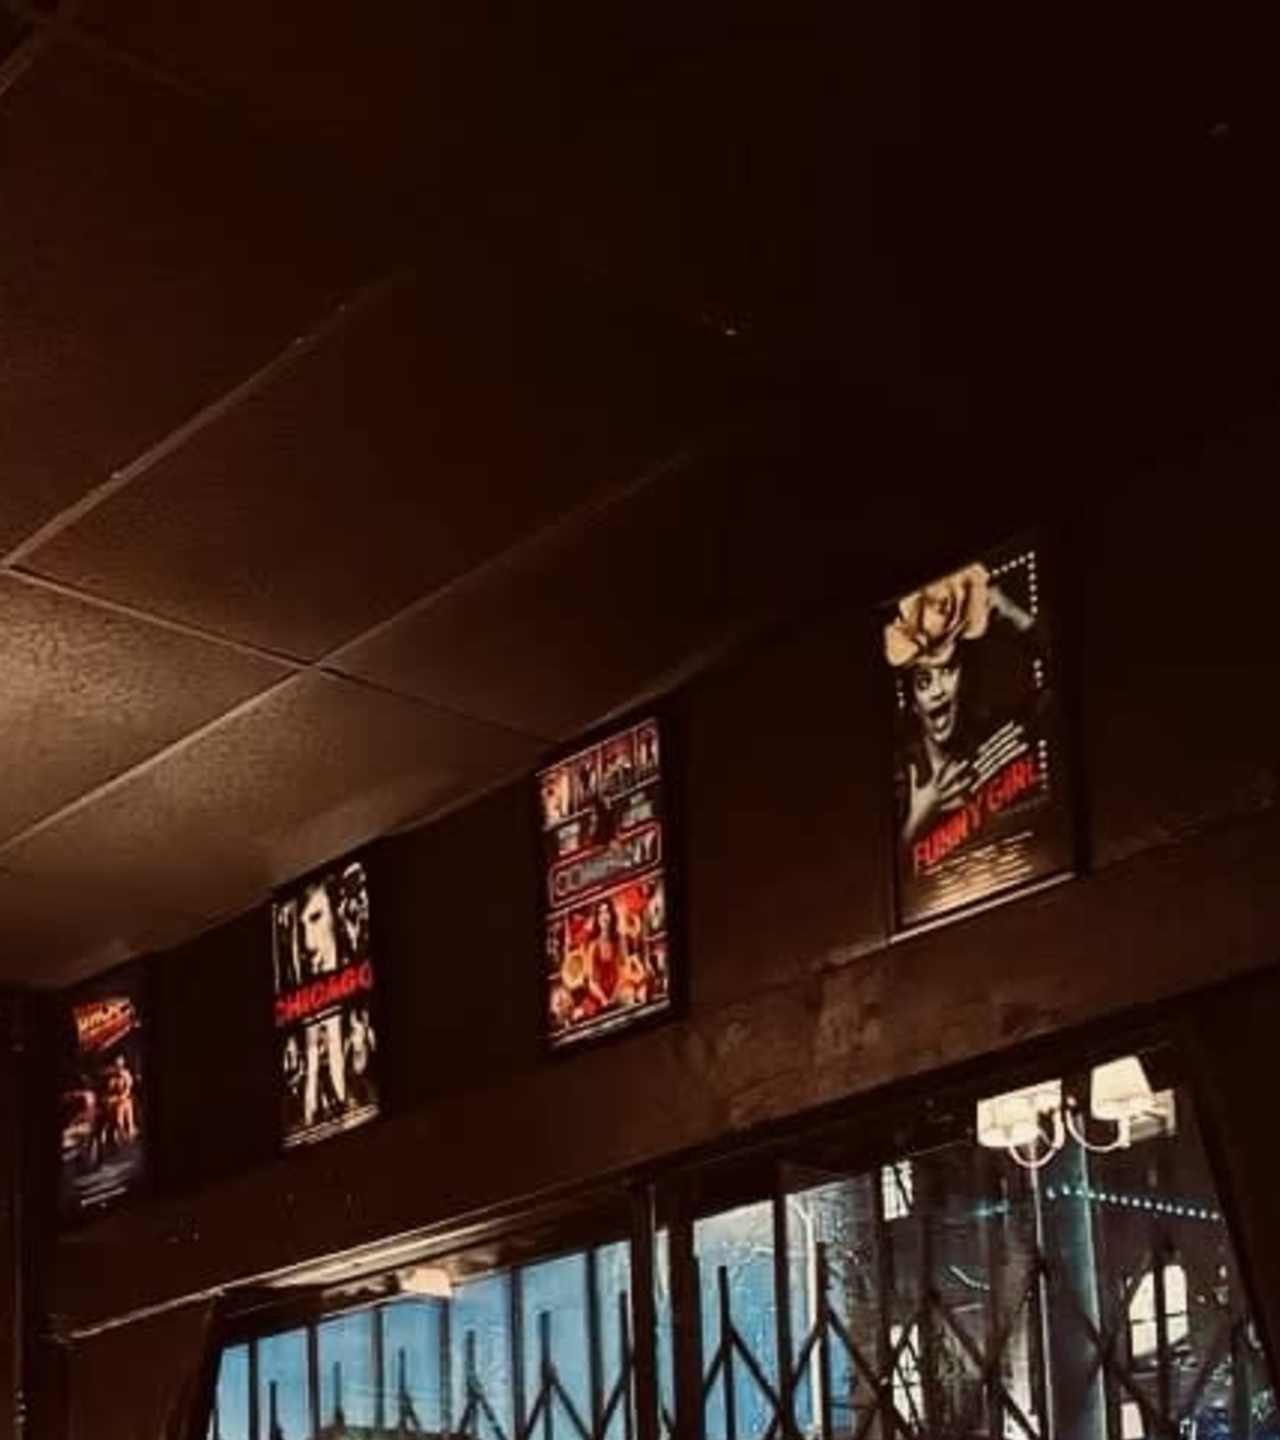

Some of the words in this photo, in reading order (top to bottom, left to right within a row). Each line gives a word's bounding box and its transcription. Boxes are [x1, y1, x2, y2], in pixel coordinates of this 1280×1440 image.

[913, 792, 984, 878] FUNNY
[986, 757, 1042, 812] GIRL
[555, 830, 656, 896] CONY
[273, 962, 373, 1025] CHICAGO
